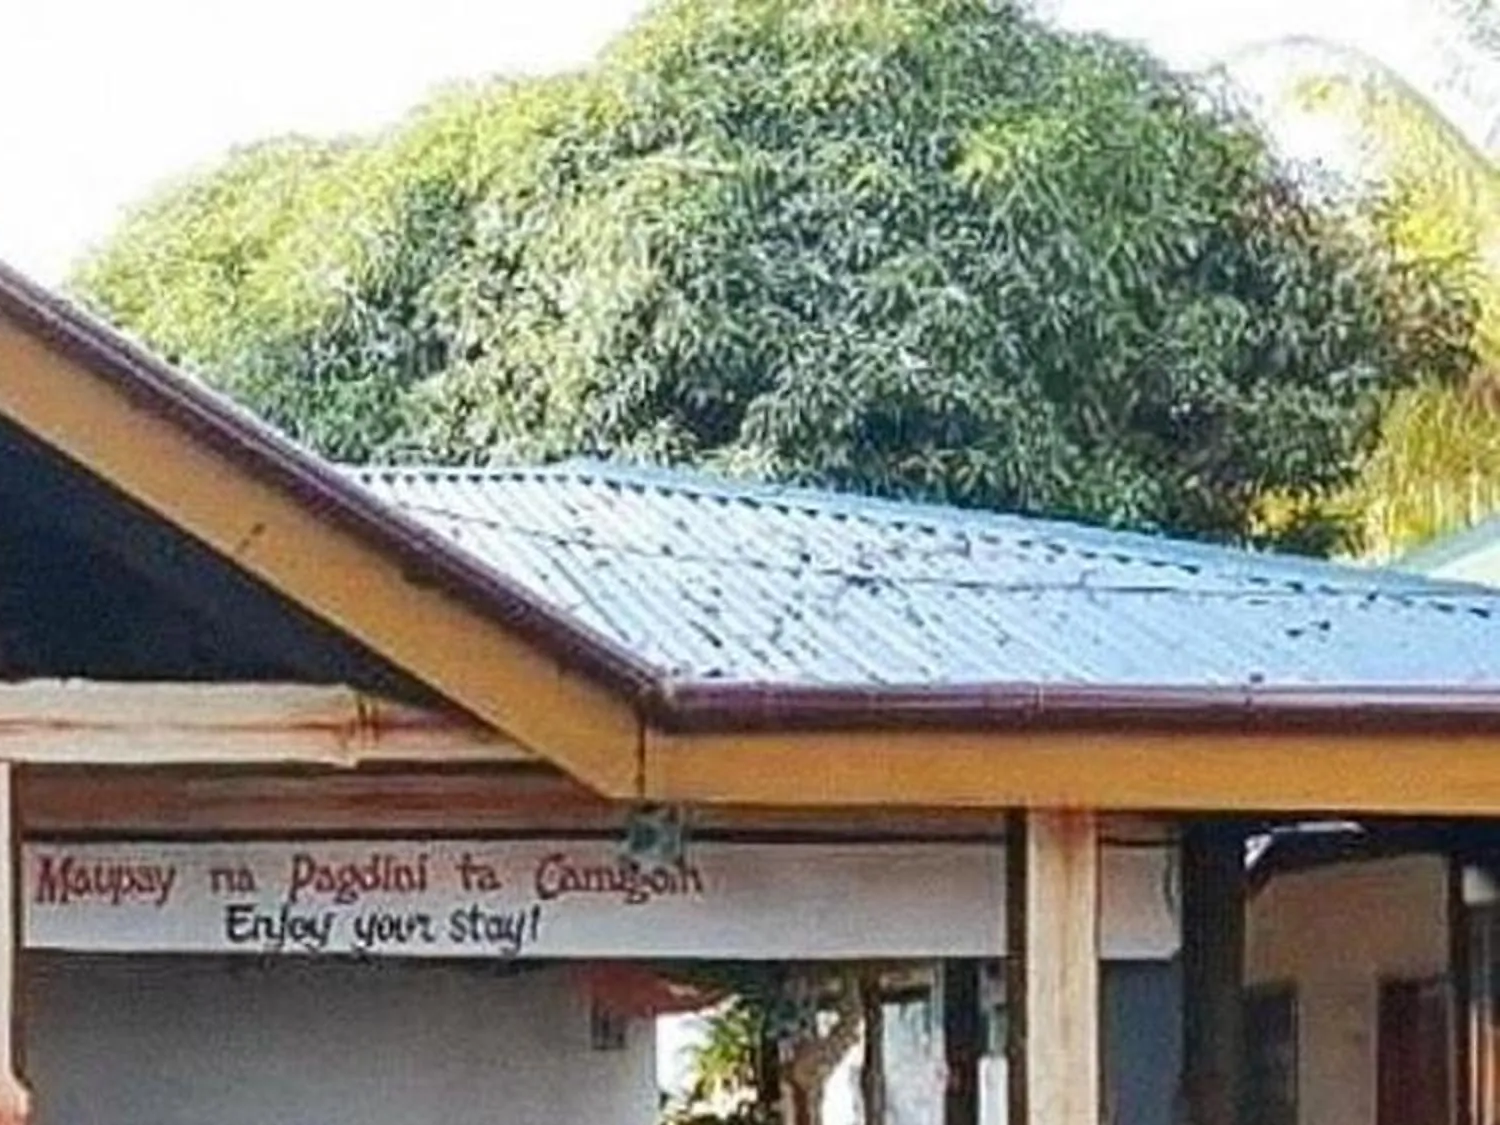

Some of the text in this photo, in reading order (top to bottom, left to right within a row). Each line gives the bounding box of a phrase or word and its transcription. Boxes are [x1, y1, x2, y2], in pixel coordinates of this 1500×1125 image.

[34, 855, 177, 907] Maupay
[209, 866, 258, 894] na
[454, 853, 502, 892] ta
[225, 903, 541, 952] Enjoy your stay!
